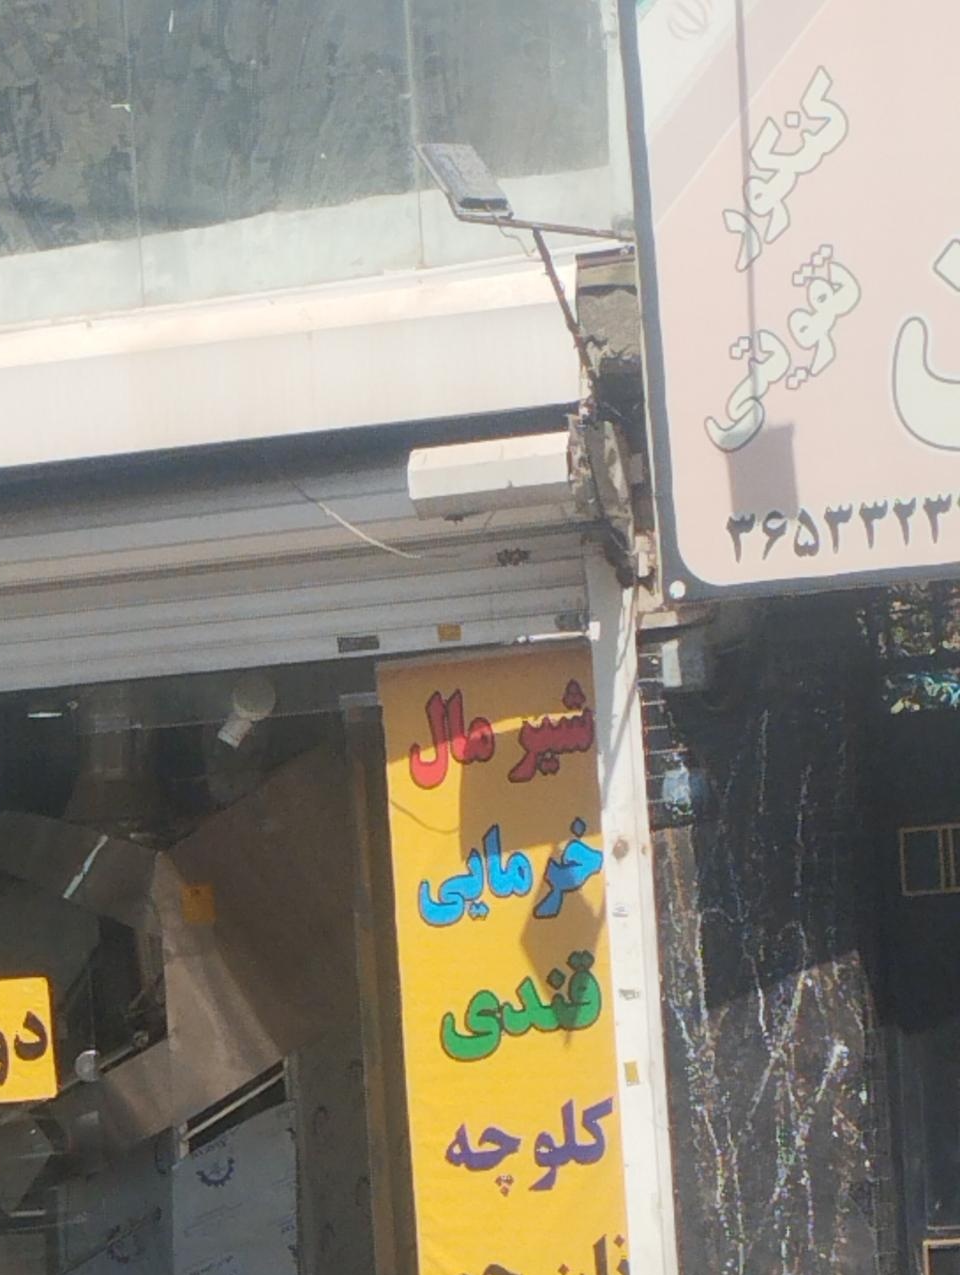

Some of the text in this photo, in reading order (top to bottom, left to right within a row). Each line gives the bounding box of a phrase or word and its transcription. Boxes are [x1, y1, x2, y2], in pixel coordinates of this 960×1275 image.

[722, 65, 849, 272] کنکور
[704, 244, 862, 452] تقویتی
[726, 493, 960, 564] ۳۶۵۳۳۲۳
[417, 817, 604, 927] خرمایی
[440, 950, 603, 1062] قندی
[444, 1096, 614, 1198] کلوچه
